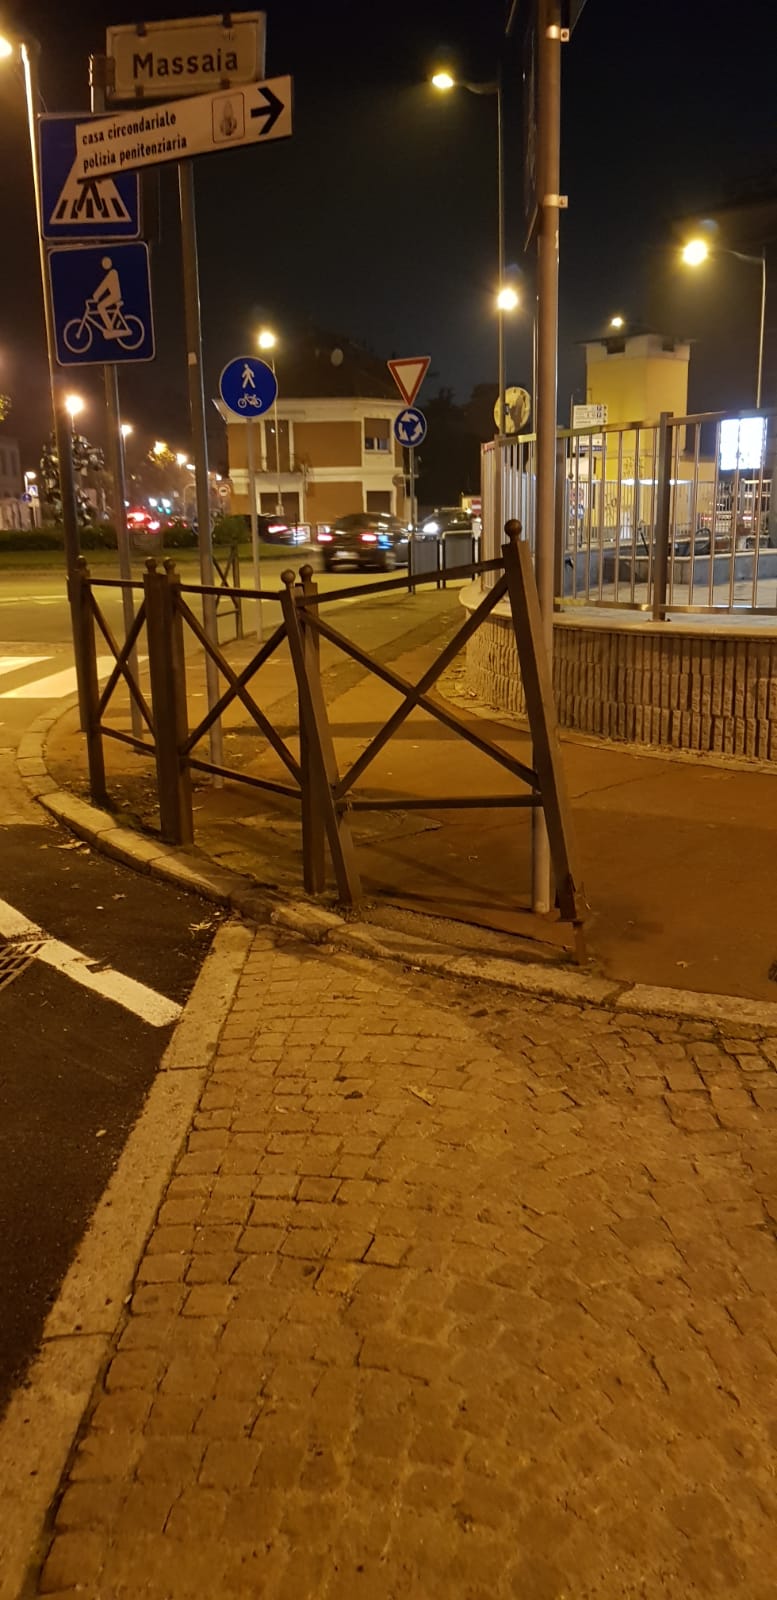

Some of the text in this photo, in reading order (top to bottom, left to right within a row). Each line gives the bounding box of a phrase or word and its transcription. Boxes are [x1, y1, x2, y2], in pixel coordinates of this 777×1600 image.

[133, 48, 238, 79] Massaia
[82, 111, 176, 146] casa circondariale
[83, 135, 187, 173] polizia penitenziaria
